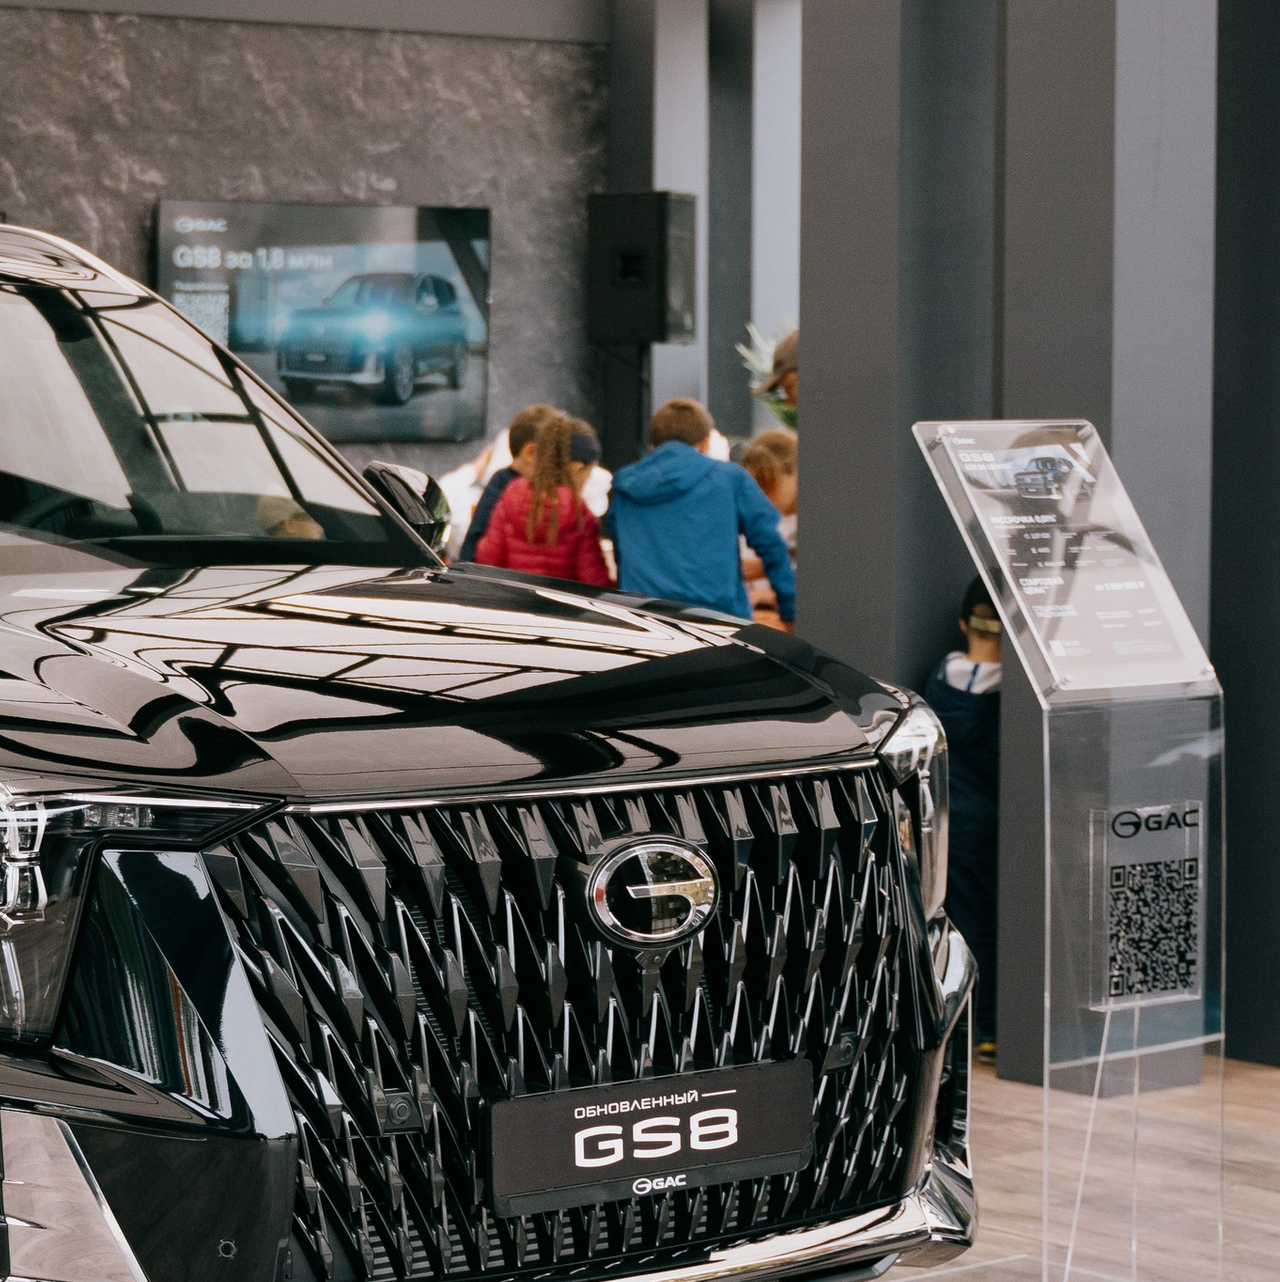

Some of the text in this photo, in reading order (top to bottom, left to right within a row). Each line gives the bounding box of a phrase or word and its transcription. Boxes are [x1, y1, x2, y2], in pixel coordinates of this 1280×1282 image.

[1144, 809, 1199, 832] GAC
[574, 1089, 699, 1119] ОБНОВЛЕННЫЙ
[574, 1108, 738, 1168] GS8
[652, 1174, 687, 1189] GAC
